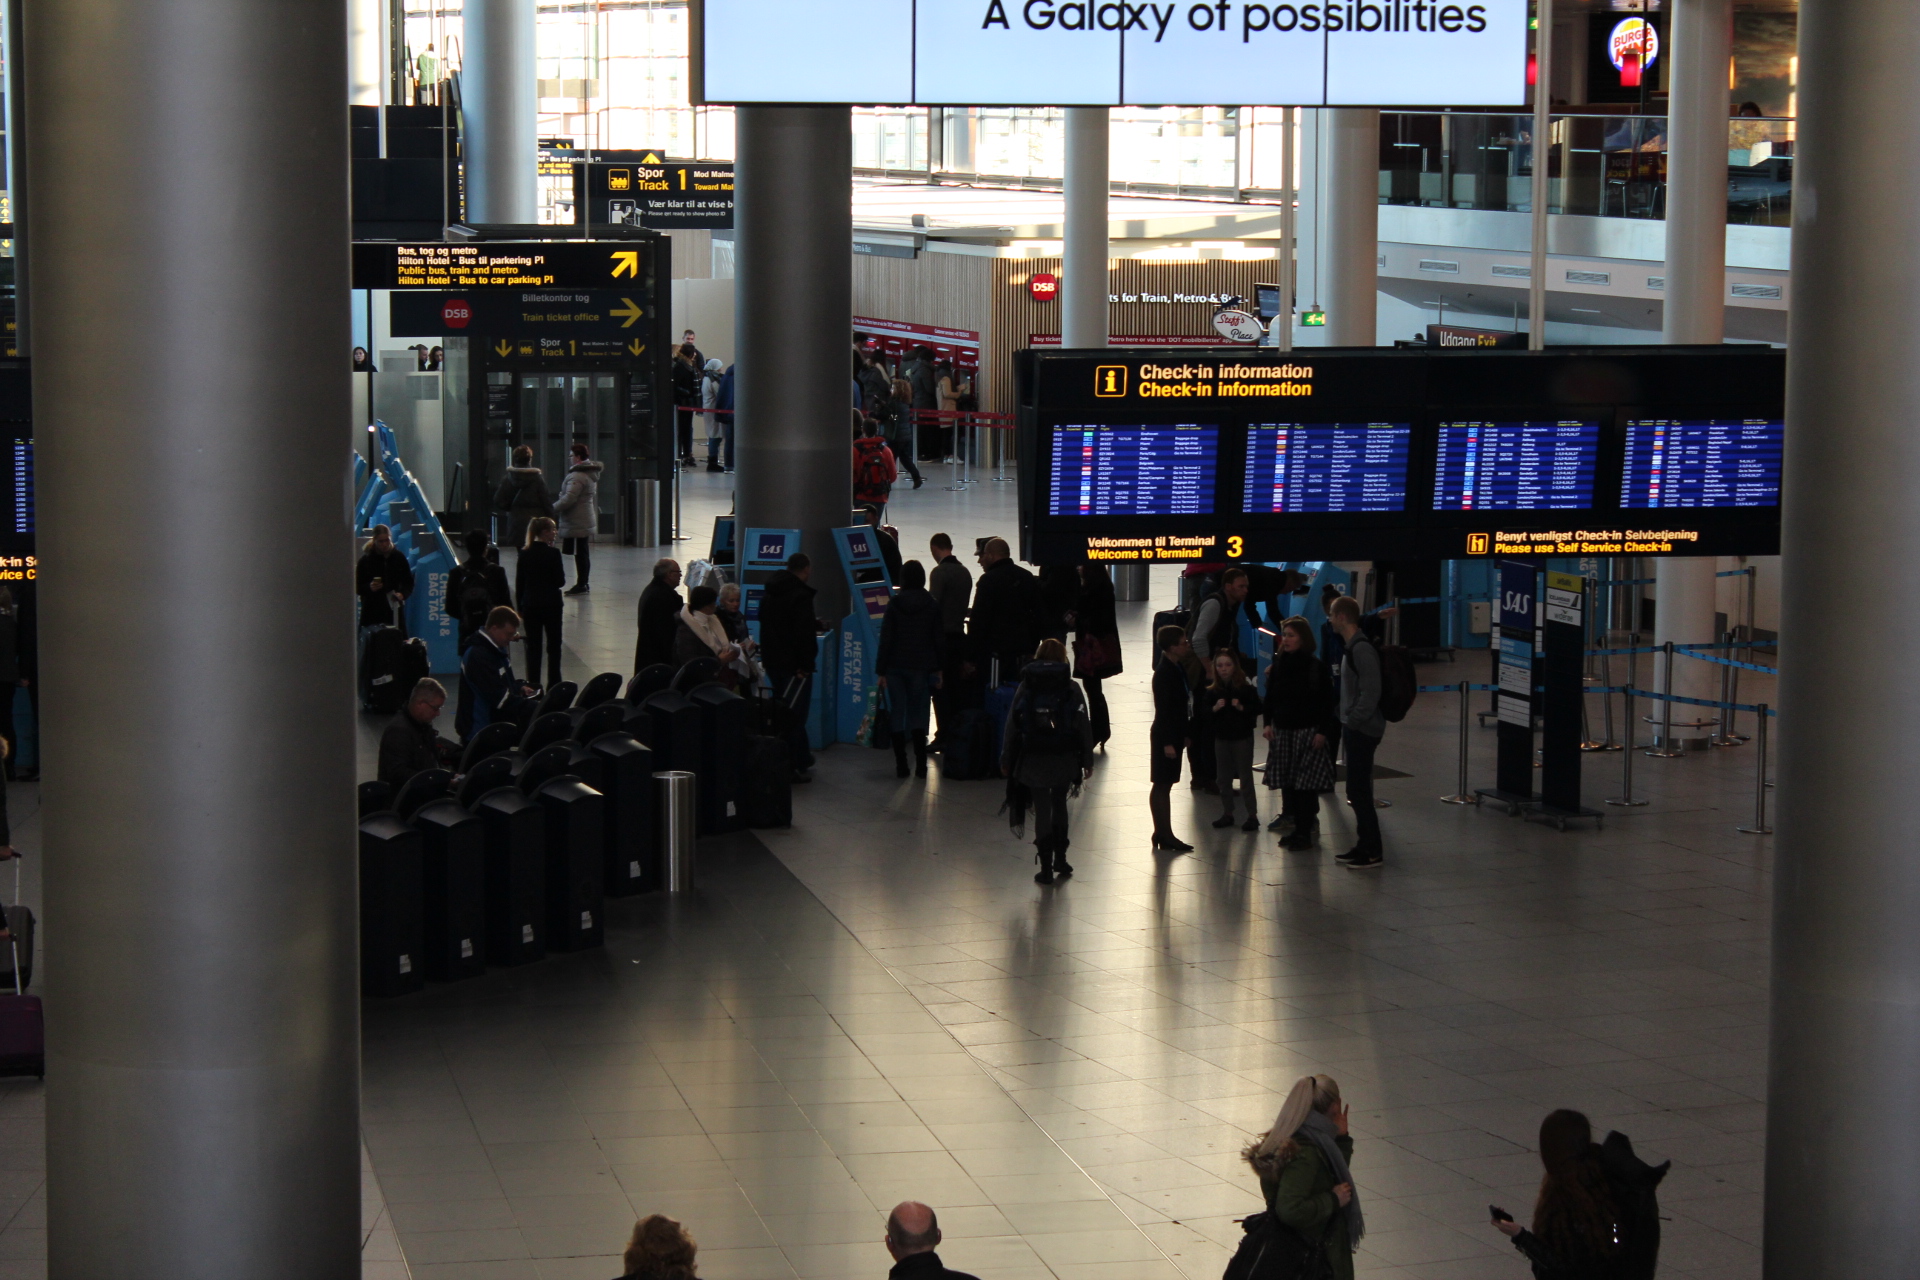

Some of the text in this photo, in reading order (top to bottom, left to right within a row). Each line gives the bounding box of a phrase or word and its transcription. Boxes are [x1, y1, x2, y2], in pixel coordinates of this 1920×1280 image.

[982, 0, 1487, 42] A Galaxy of possibilities
[638, 167, 665, 179] Spor
[638, 180, 669, 190] Track
[678, 169, 686, 191] 1
[398, 247, 417, 255] Bus,
[419, 247, 434, 257] tog
[437, 248, 449, 257] og
[398, 256, 424, 264] Hilton
[427, 256, 450, 264] Hotel
[459, 256, 476, 264] Bus
[478, 256, 487, 264] til
[490, 256, 532, 266] parkering
[429, 266, 447, 275] bus,
[450, 266, 470, 274] train
[398, 276, 424, 284] Hilton
[427, 276, 450, 284] Hotel
[508, 276, 541, 285] parking
[544, 275, 553, 283] P1
[1033, 282, 1055, 291] DSB
[522, 294, 589, 304] Billetkontor tog
[1122, 293, 1138, 302] for
[1141, 293, 1170, 304] Train,
[1174, 294, 1207, 302] Metro
[445, 309, 469, 318] DSB
[547, 313, 571, 321] ticket
[574, 313, 600, 321] office
[540, 338, 576, 356] Spor 1
[1140, 364, 1213, 379] Check-in
[1219, 364, 1313, 378] information
[1139, 381, 1312, 397] Check-in information
[1088, 536, 1215, 548] Velkommen til Terminal
[1495, 530, 1698, 543] Benyt venligst Check-in Selvbetjening
[760, 545, 783, 554] SAS
[853, 543, 867, 553] SAS
[1227, 536, 1243, 557] 3
[1494, 542, 1672, 553] Please use Self Service Check-in
[1087, 547, 1202, 559] Welcome to Terminal
[428, 573, 439, 621] BAG TAG
[1502, 590, 1530, 615] SAS
[440, 628, 450, 636] &
[844, 631, 853, 685] BAG TAG
[852, 641, 862, 703] HECK IN &
